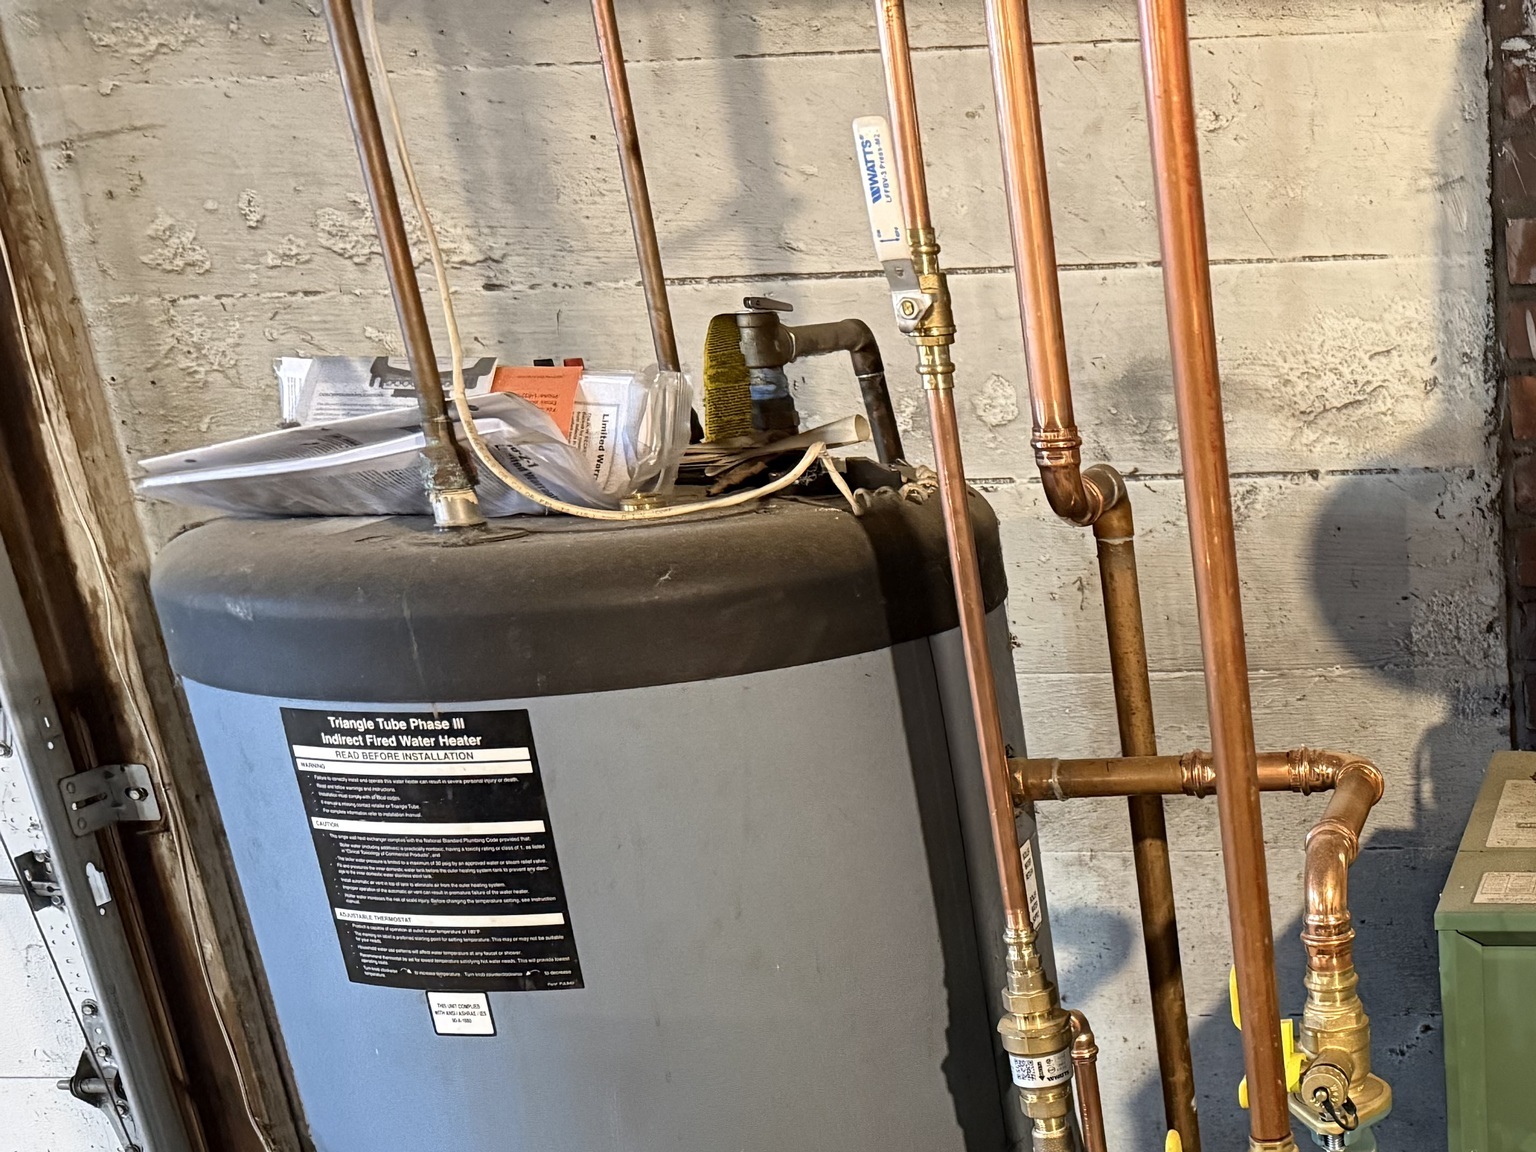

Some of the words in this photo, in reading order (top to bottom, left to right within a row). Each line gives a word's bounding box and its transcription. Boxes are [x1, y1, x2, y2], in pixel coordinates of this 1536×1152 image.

[861, 138, 879, 188] WATTS
[598, 414, 610, 451] Limited
[327, 716, 375, 732] Triangle
[376, 718, 407, 730] Tube
[409, 718, 450, 730] Phase
[452, 718, 465, 729] III
[321, 732, 364, 746] Indirect
[365, 734, 397, 746] Fired
[399, 735, 435, 747] Water
[439, 735, 482, 746] Heater
[335, 750, 360, 760] READ
[362, 752, 400, 760] BEFORE
[402, 751, 474, 760] INSTALLATION
